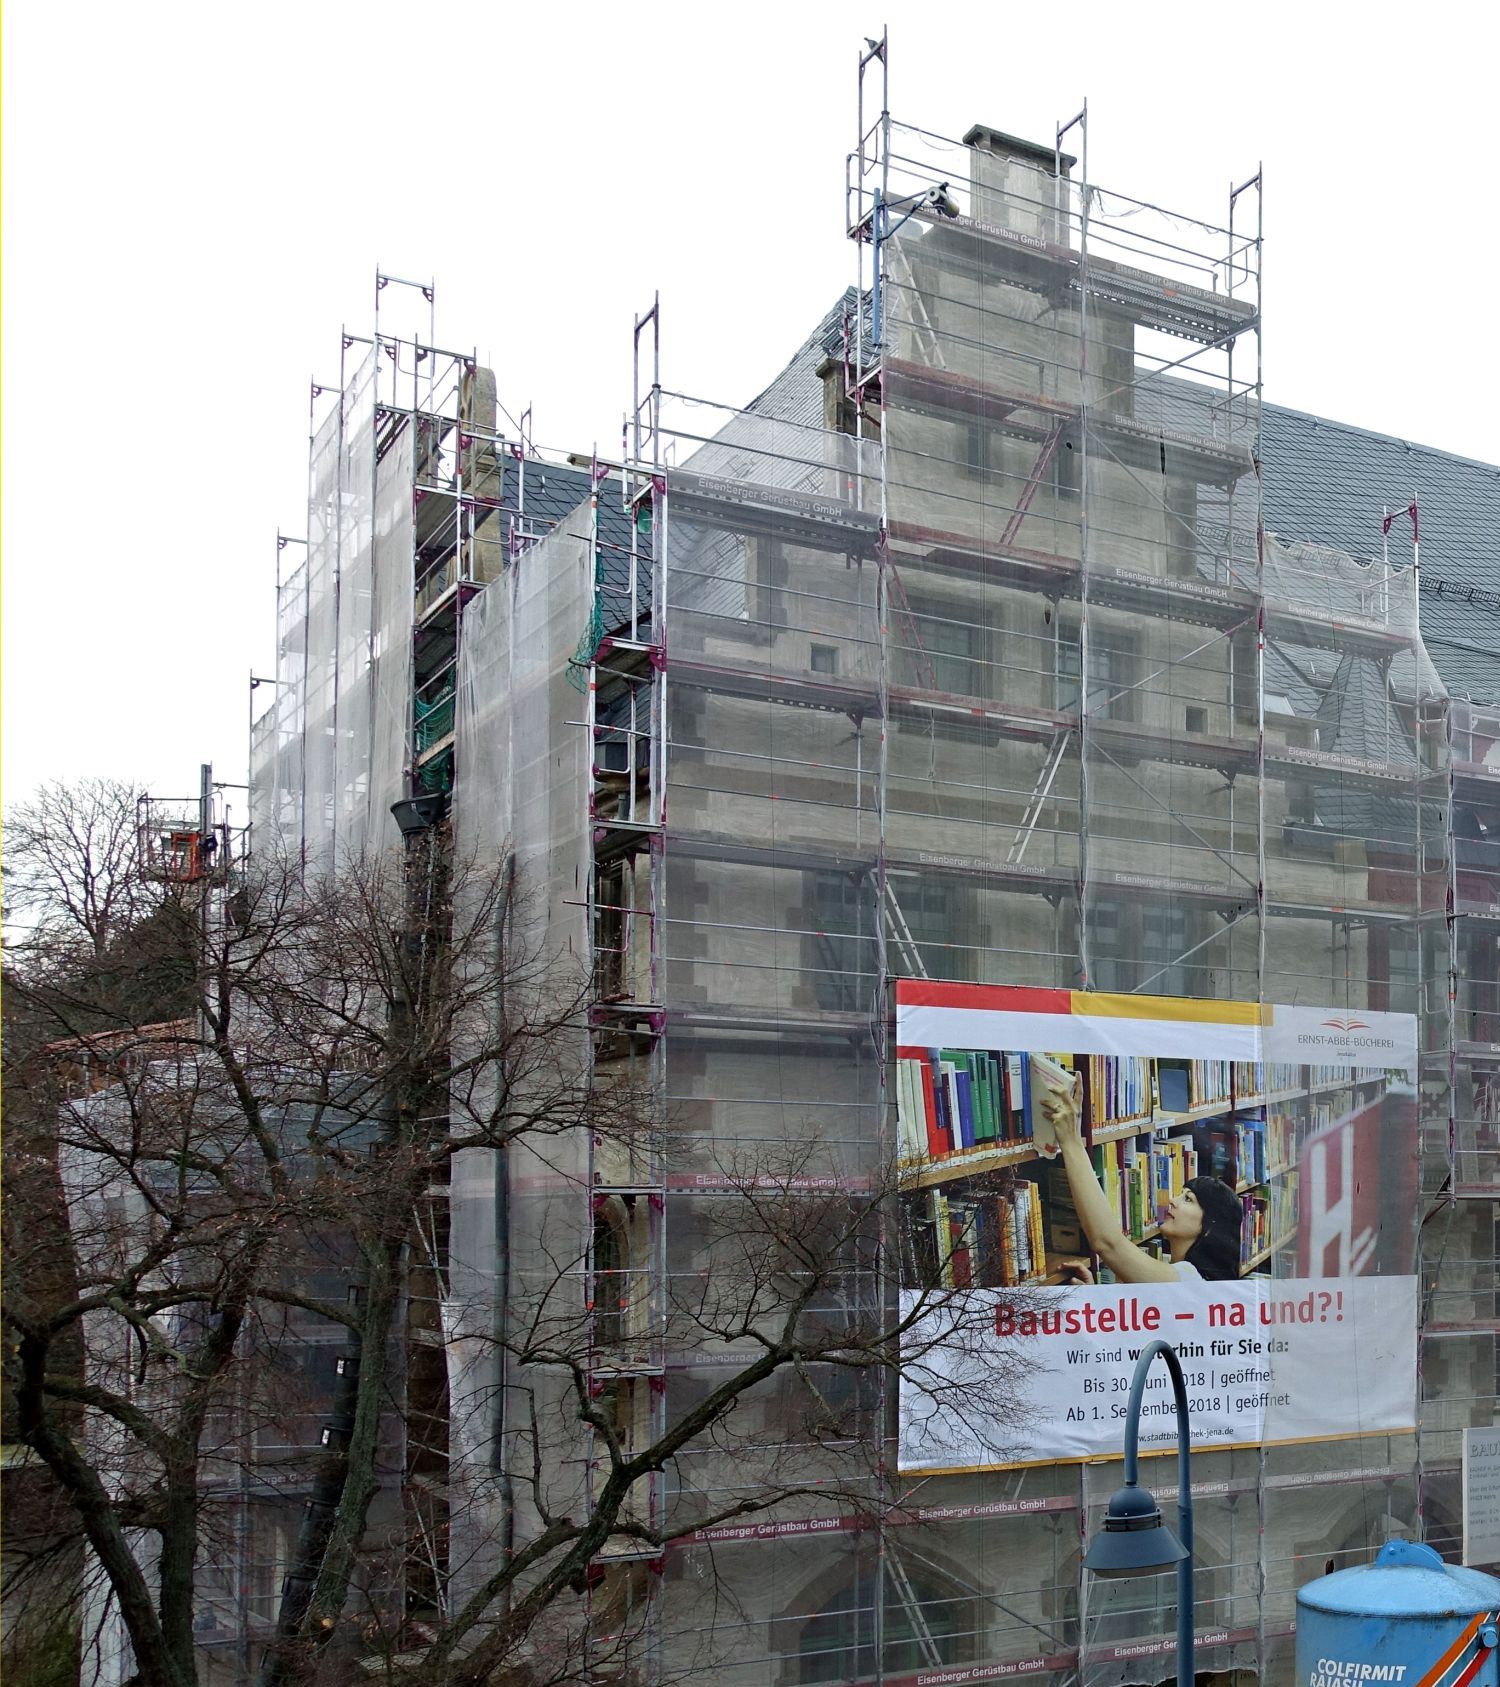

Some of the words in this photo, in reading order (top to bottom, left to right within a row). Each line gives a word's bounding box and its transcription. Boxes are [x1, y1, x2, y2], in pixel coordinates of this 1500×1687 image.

[1021, 234, 1047, 249] GmbH
[812, 504, 843, 517] GmbH
[1297, 1034, 1394, 1049] ERNST-ABBE-BÜCHEREI
[994, 1297, 1161, 1337] Baustelle
[1208, 1302, 1246, 1327] na
[1260, 1290, 1344, 1326] und?!
[1066, 1349, 1090, 1365] Wir
[1095, 1347, 1122, 1363] sind
[1128, 1341, 1204, 1361] wtrhin
[1210, 1340, 1234, 1357] für
[1238, 1338, 1262, 1355] Sie
[1267, 1337, 1289, 1353] da:
[1083, 1378, 1105, 1394] Bis
[1111, 1377, 1132, 1393] 30.
[1145, 1373, 1167, 1390] uni
[1182, 1372, 1206, 1388] 018
[1220, 1367, 1277, 1388] geöffnet
[1066, 1406, 1085, 1422] Ab
[1091, 1406, 1105, 1420] 1.
[1110, 1400, 1179, 1419] Seembe
[1188, 1397, 1221, 1413] 2018
[1235, 1392, 1291, 1413] geöffnet
[973, 1503, 1018, 1515] Gerüstbau
[1019, 1499, 1046, 1511] GmbH
[810, 1518, 840, 1530] GmbH
[1114, 1641, 1162, 1657] Eisenberger
[1204, 1632, 1228, 1644] GmbH
[917, 1669, 971, 1686] Eisenberger
[972, 1664, 1017, 1678] Gerüstbau
[1018, 1658, 1045, 1671] GmbH
[1317, 1658, 1407, 1682] COLFIRMIT
